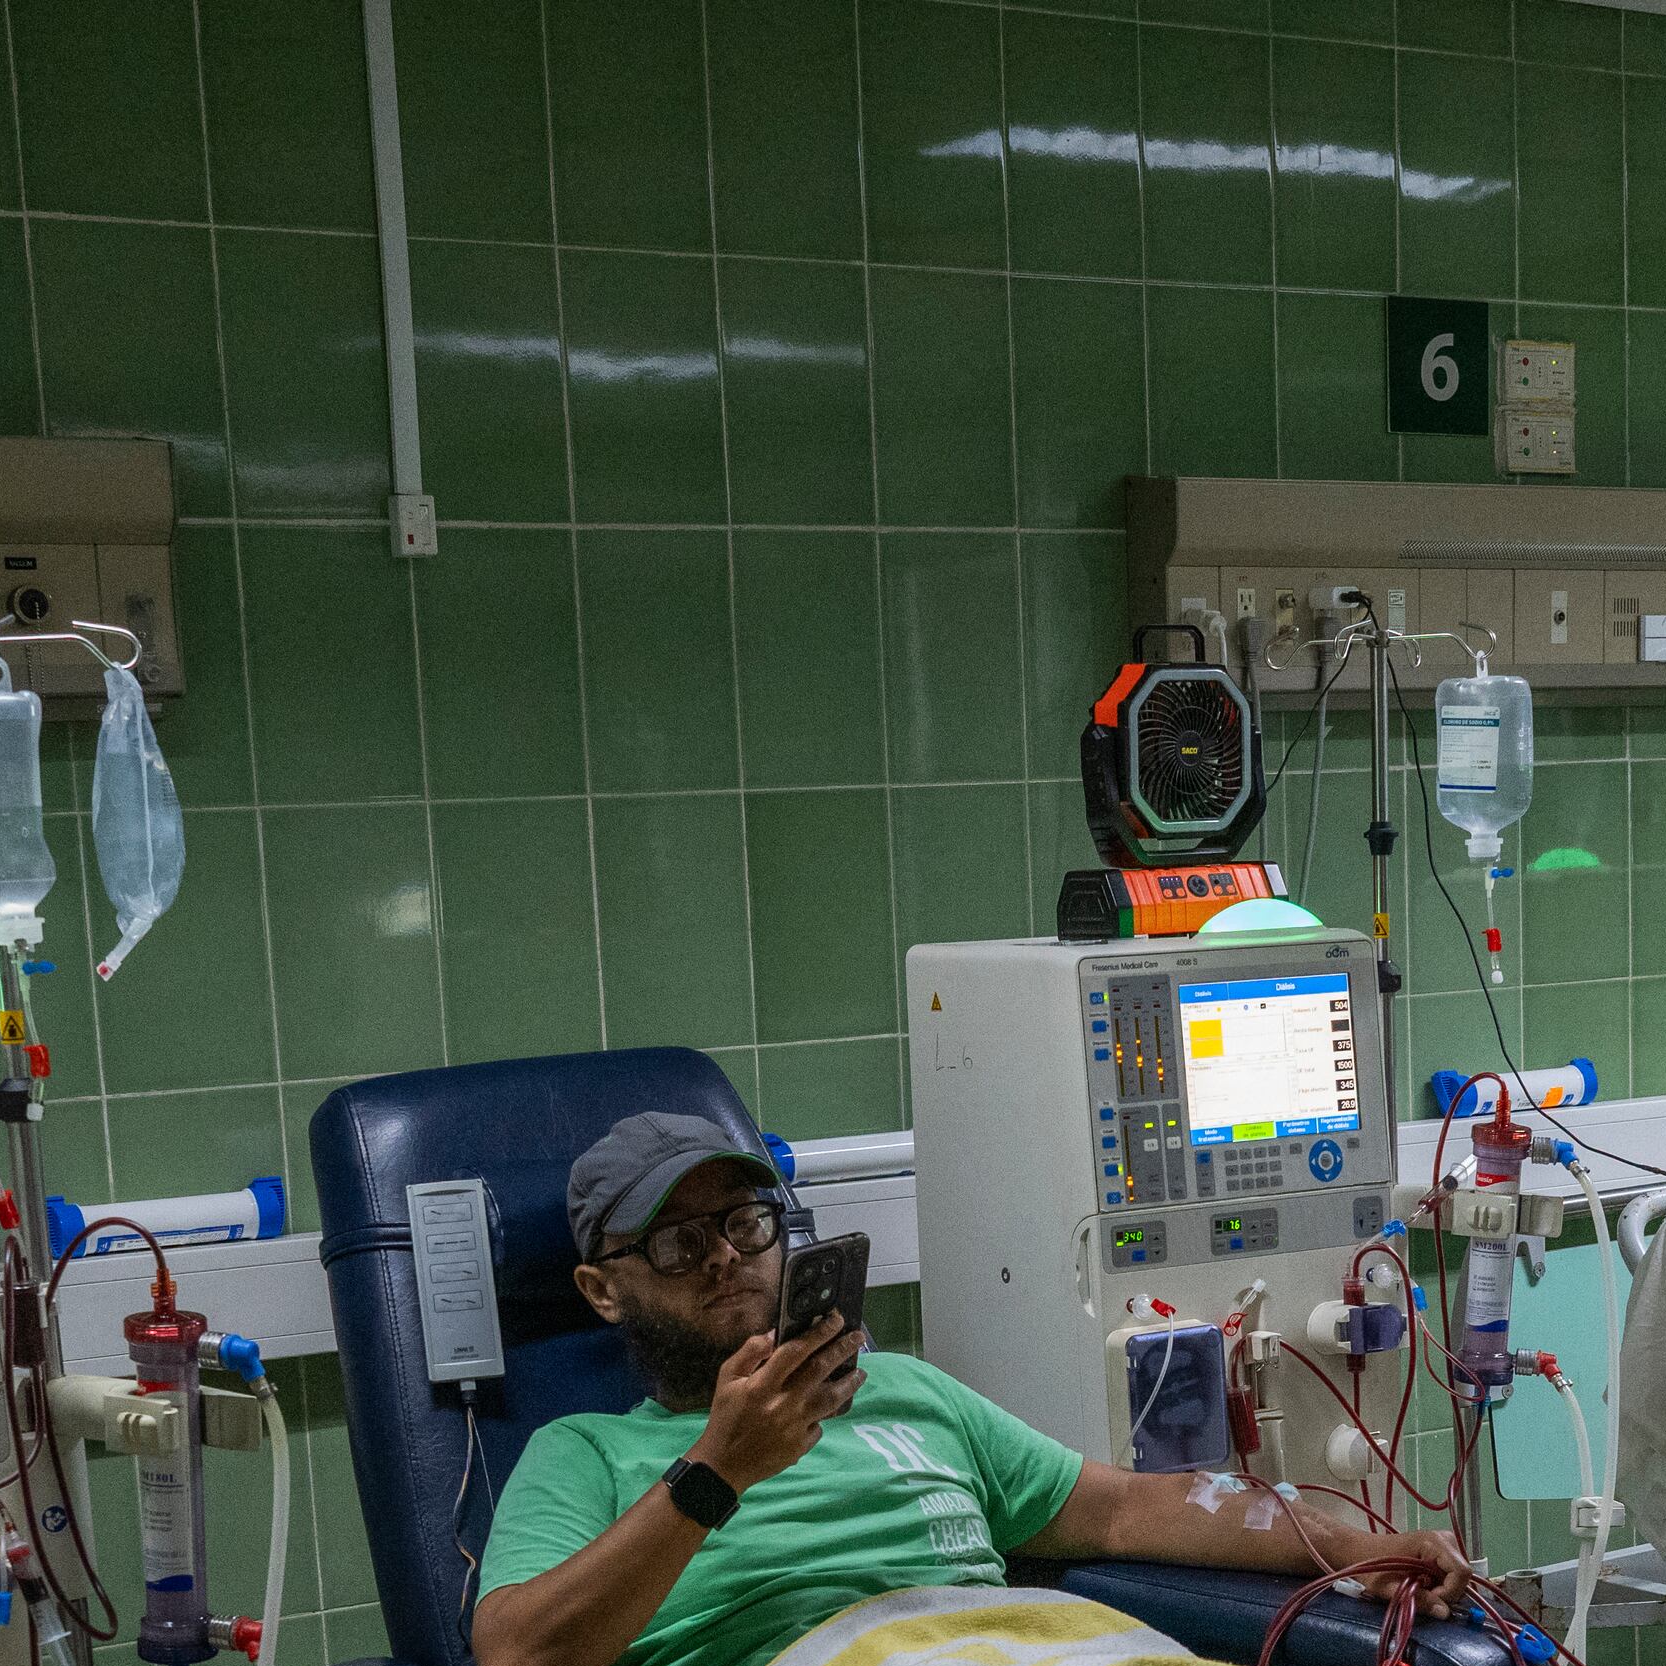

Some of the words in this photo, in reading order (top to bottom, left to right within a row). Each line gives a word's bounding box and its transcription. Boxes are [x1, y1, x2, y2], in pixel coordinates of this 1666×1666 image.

[1420, 333, 1461, 402] 6
[1181, 747, 1198, 755] SACO
[1091, 963, 1120, 972] Fresenius
[1120, 961, 1143, 970] Medical
[1143, 960, 1159, 969] Care
[1176, 958, 1192, 967] 4008
[1334, 1001, 1348, 1010] 504
[1337, 1040, 1351, 1050] 375
[1336, 1060, 1352, 1069] 1500
[1340, 1080, 1354, 1089] 345
[1123, 1230, 1143, 1243] 340
[1474, 1240, 1508, 1251] SM200L
